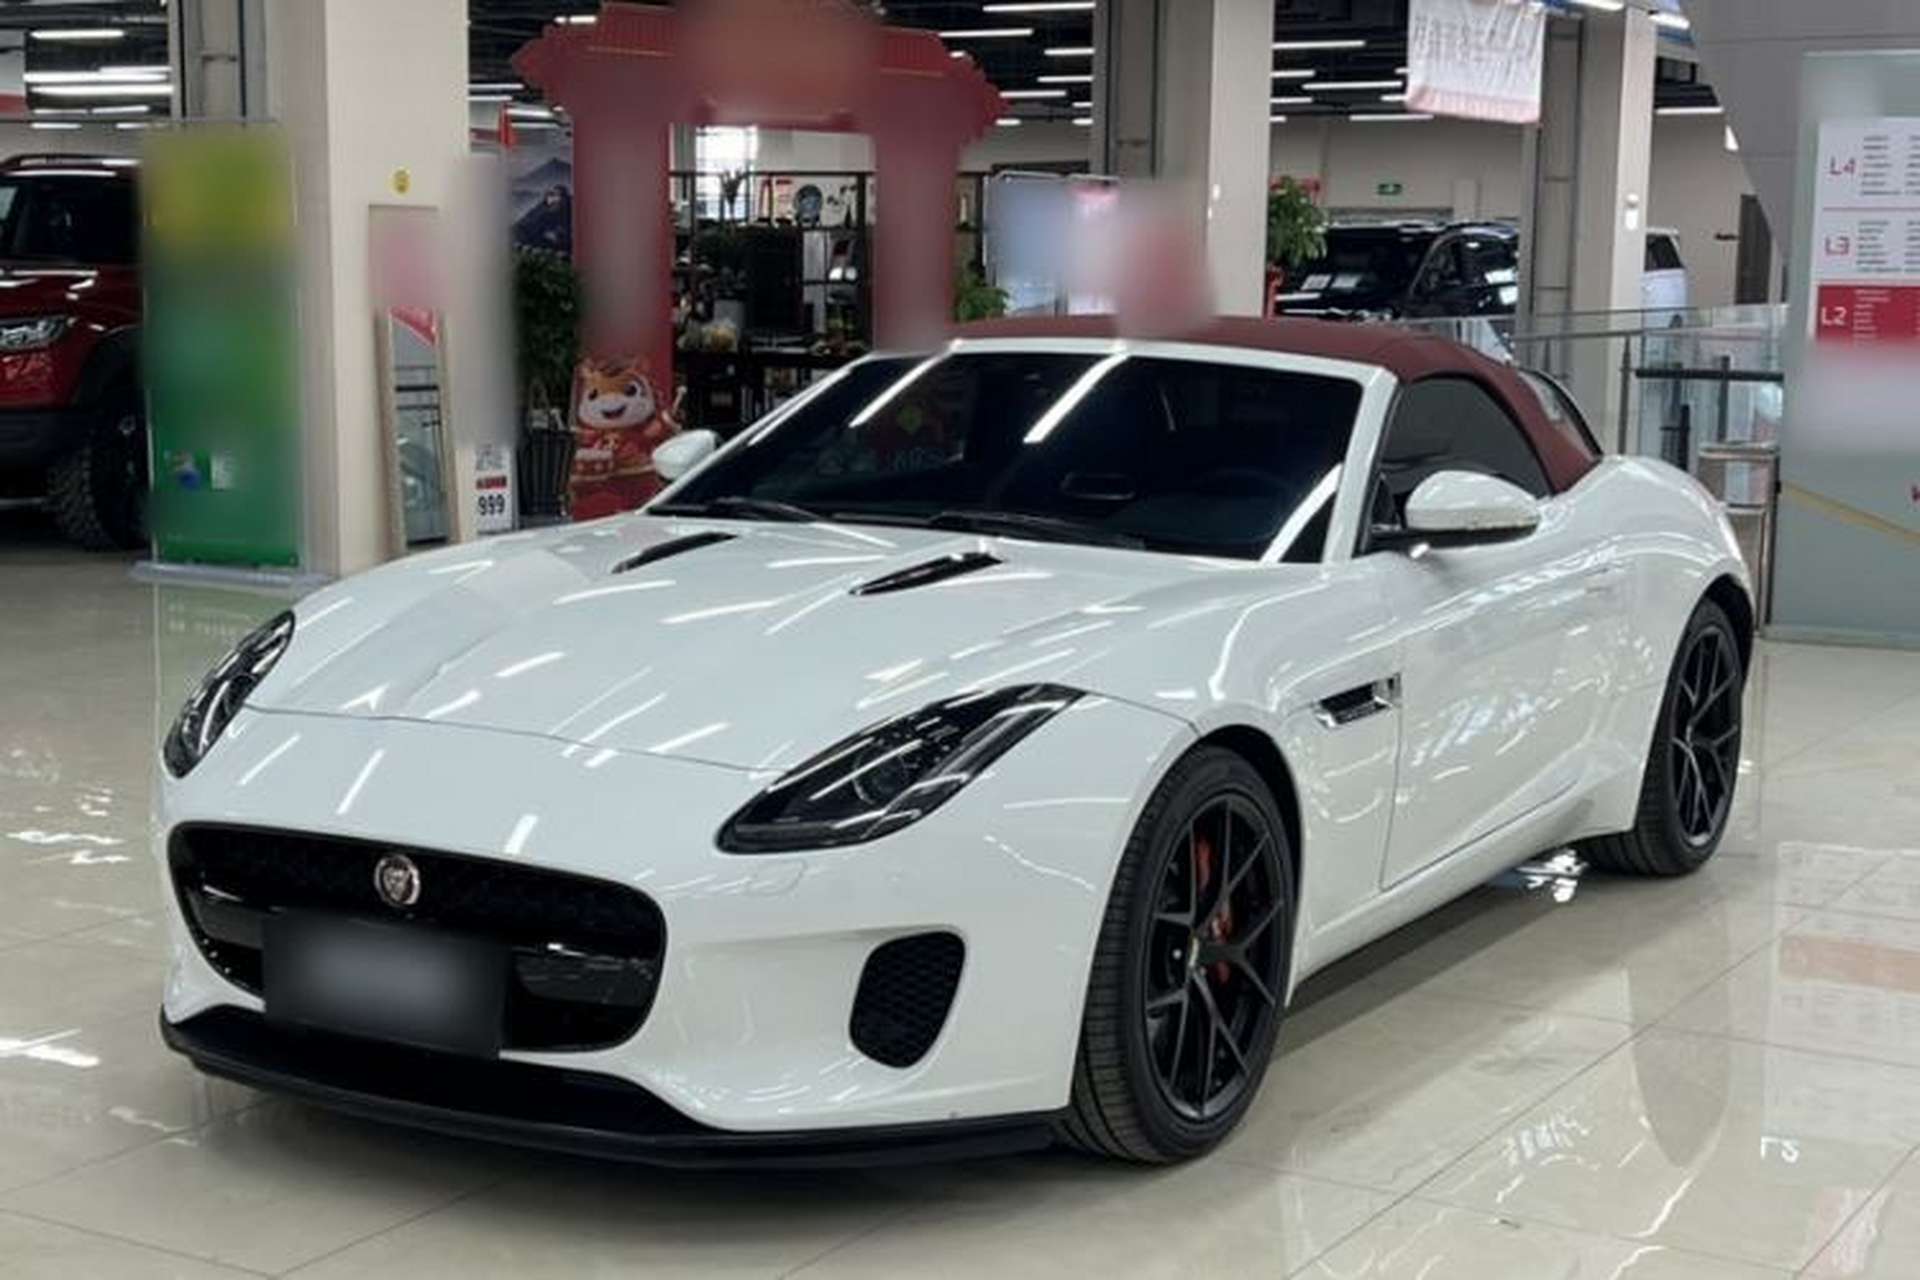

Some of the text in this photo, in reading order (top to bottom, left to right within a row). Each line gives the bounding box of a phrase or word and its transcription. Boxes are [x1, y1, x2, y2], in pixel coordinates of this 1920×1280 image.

[1829, 156, 1855, 176] L4
[1824, 235, 1850, 256] L3
[1820, 306, 1848, 327] L2
